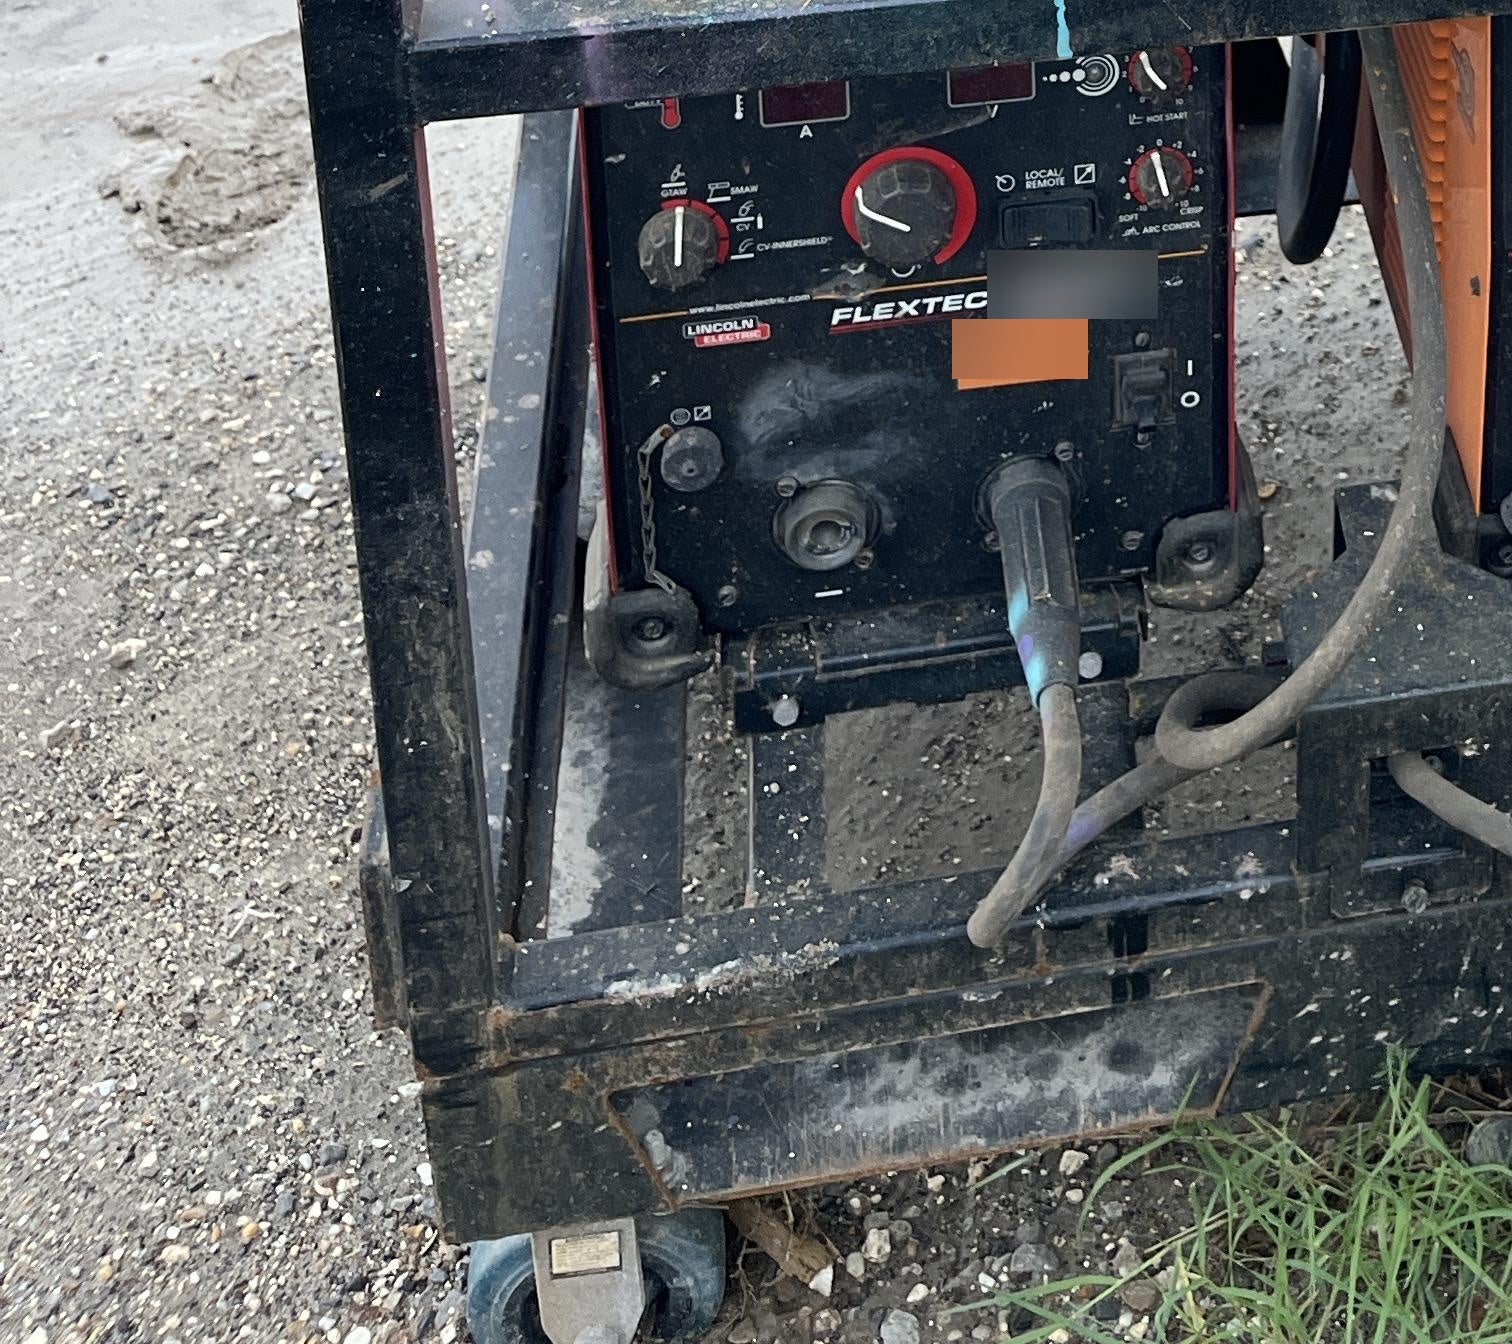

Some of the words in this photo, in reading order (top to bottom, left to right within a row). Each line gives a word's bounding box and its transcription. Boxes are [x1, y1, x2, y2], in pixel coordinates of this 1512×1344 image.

[1165, 112, 1188, 120] START
[800, 125, 812, 138] A
[1025, 168, 1064, 180] LOCAL/
[730, 184, 758, 194] SMAW
[1026, 176, 1064, 189] REMOTE
[660, 187, 688, 196] GTAW
[736, 223, 750, 232] CV
[1142, 225, 1160, 234] ARC
[1162, 220, 1200, 231] CONTROL
[831, 291, 988, 326] FLEXTEC
[687, 318, 754, 336] LINCOLN
[703, 329, 762, 344] ELECTRIC
